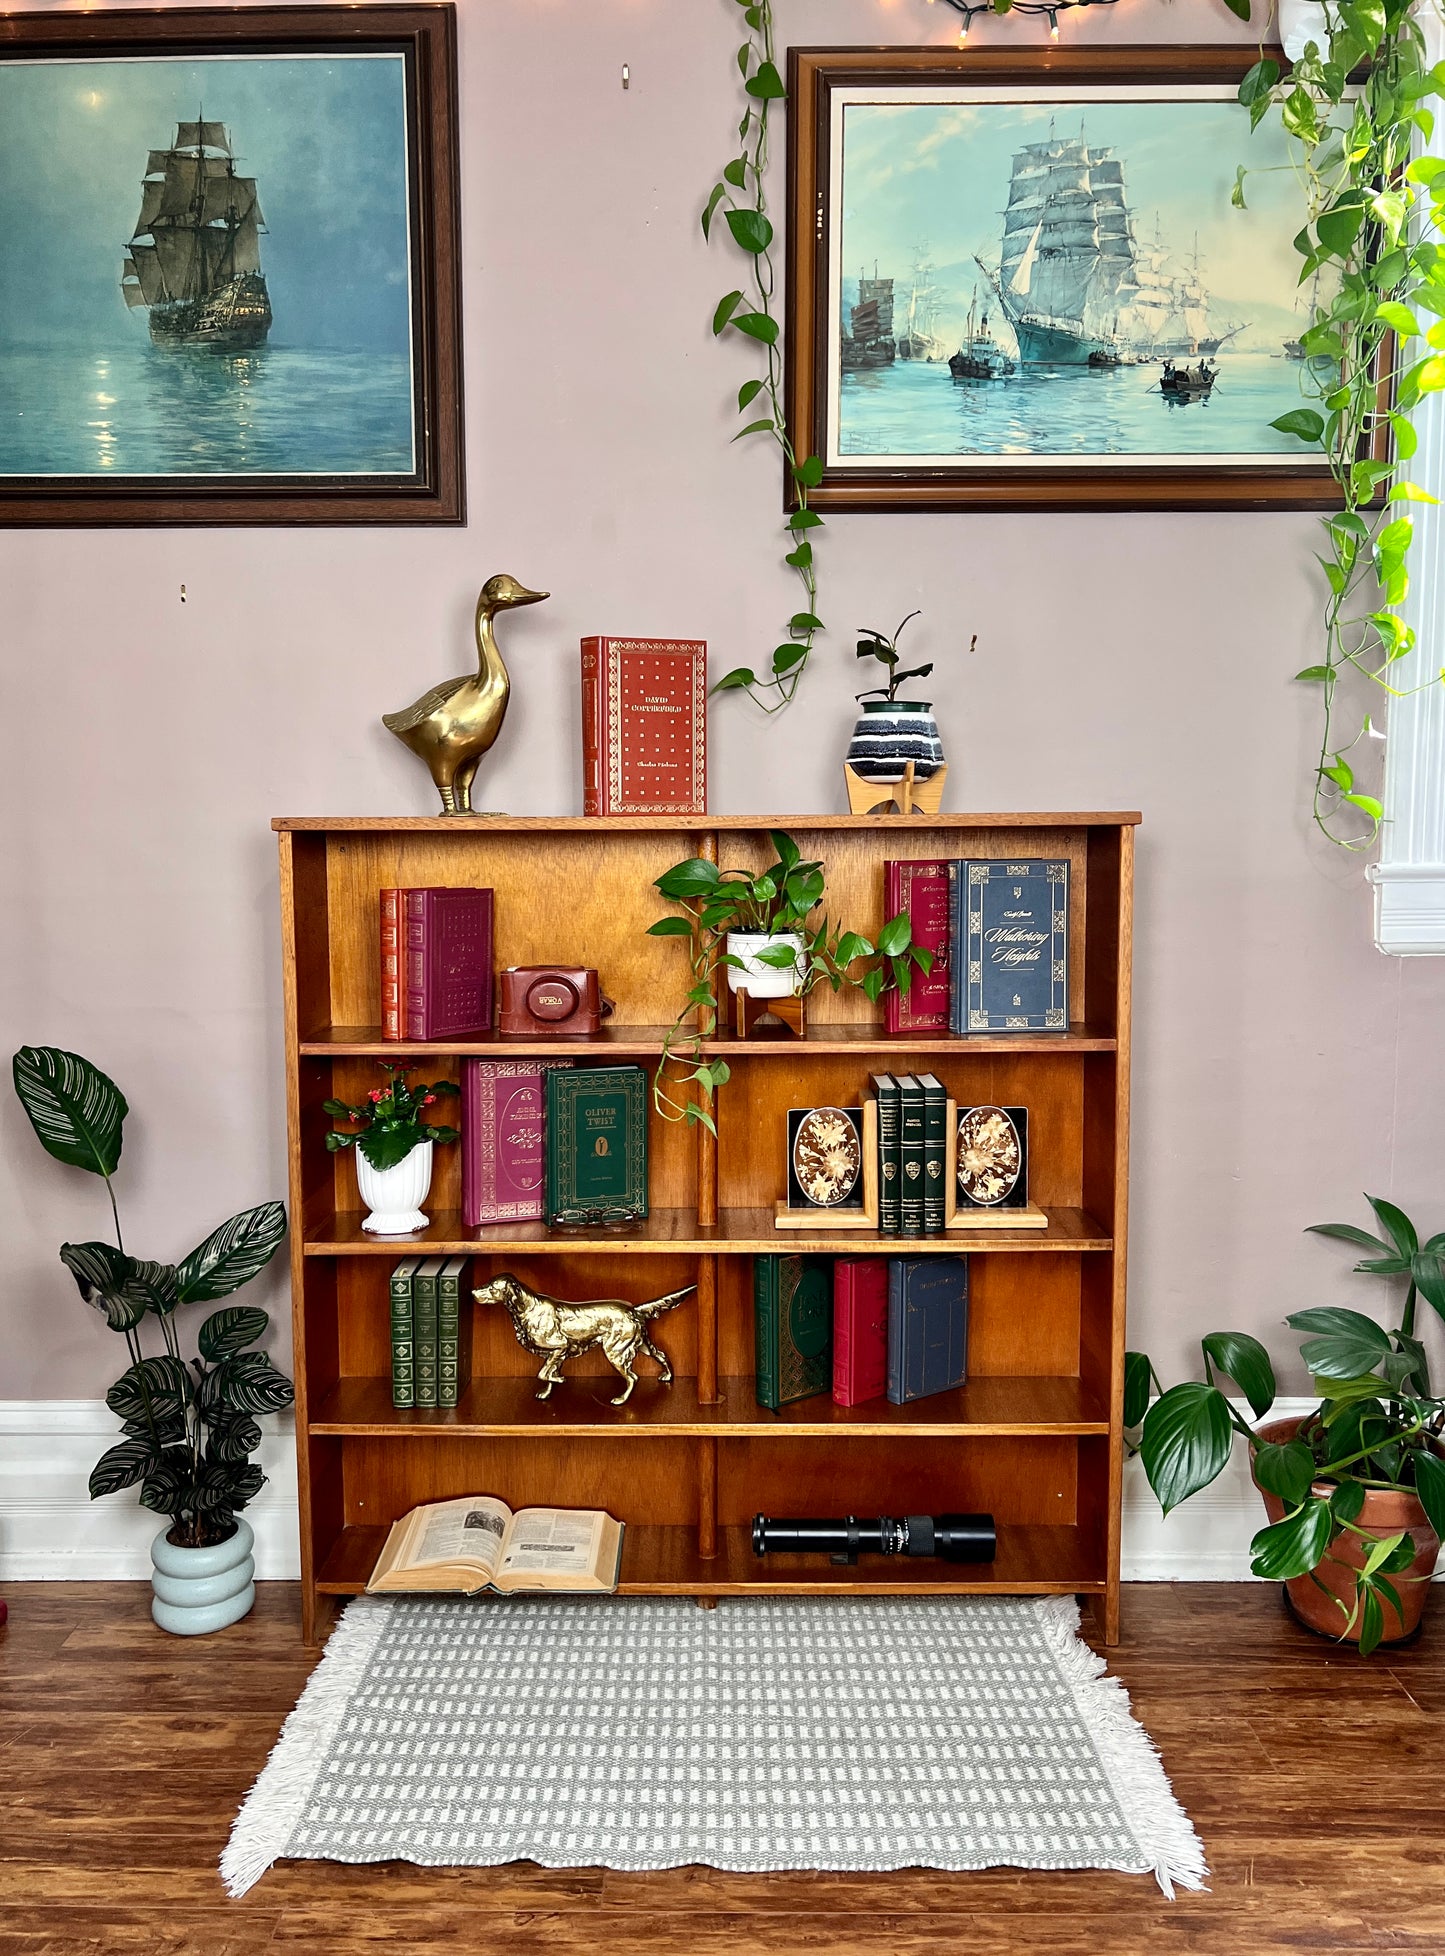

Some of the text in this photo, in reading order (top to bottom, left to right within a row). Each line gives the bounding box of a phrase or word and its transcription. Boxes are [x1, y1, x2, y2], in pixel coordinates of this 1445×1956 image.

[984, 927, 1050, 947] Wuthering
[991, 946, 1041, 967] Heights
[585, 1108, 617, 1117] OLIVER
[588, 1116, 614, 1126] TWIST
